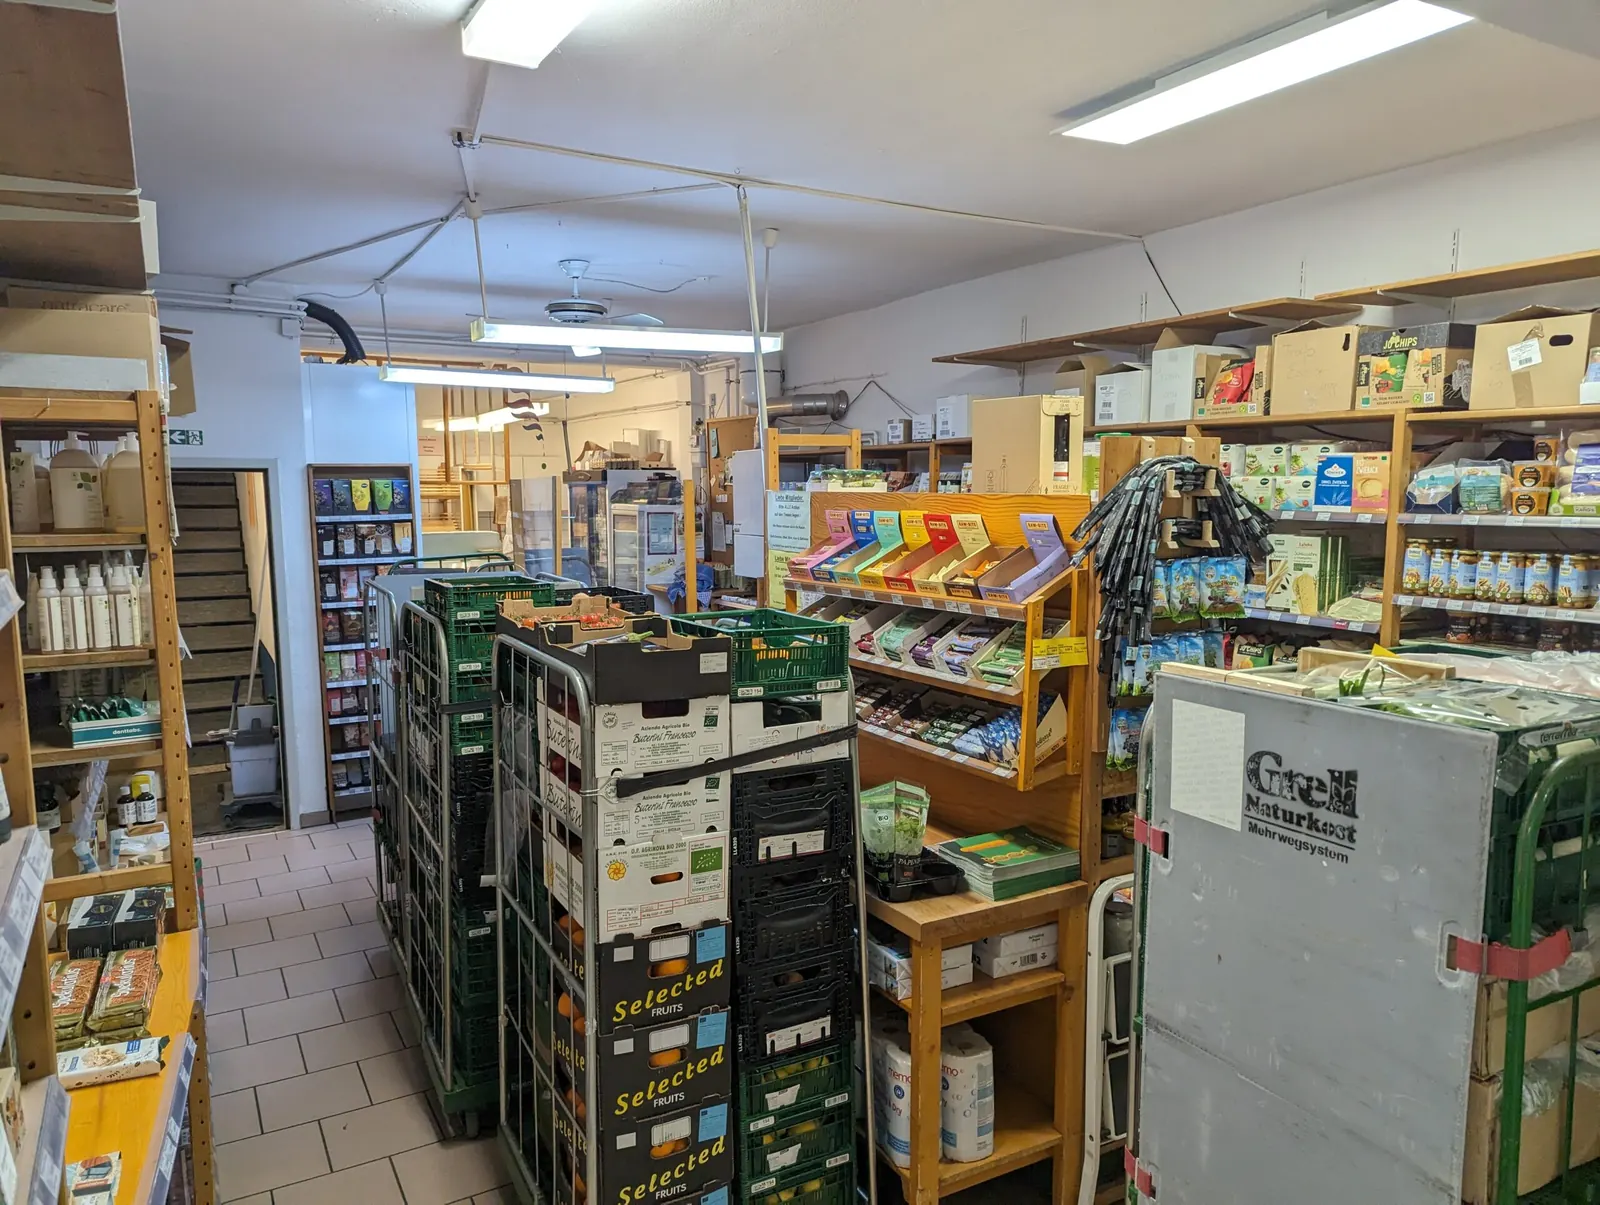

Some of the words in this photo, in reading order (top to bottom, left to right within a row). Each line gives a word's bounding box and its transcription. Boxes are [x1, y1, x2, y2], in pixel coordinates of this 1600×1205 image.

[1394, 336, 1418, 348] CHIPS
[1245, 793, 1357, 844] Naturkost
[1248, 821, 1348, 864] Mehrwegsystem
[612, 959, 724, 1022] Selected
[652, 1003, 684, 1017] FRUITS
[614, 1045, 724, 1115] Selected
[653, 1092, 685, 1108] FRUITS
[618, 1135, 725, 1205] Selected
[655, 1183, 687, 1200] FRUITS
